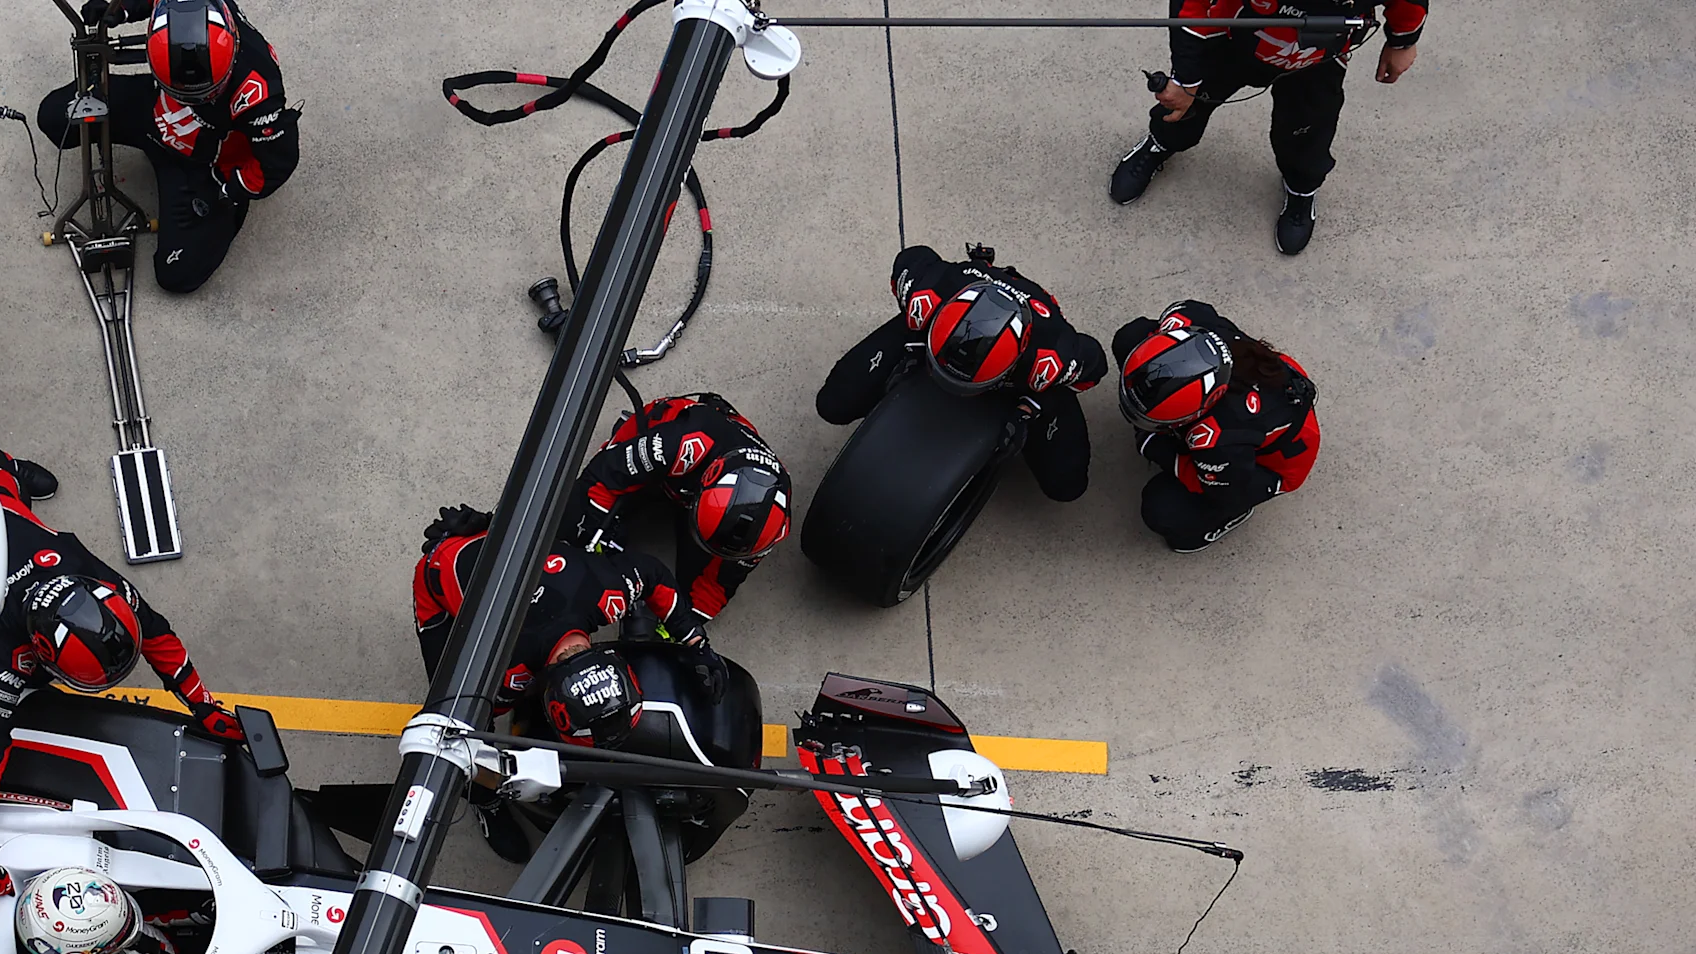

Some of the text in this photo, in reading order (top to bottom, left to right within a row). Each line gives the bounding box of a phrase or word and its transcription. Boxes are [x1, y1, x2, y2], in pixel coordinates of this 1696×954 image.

[569, 664, 620, 697] Angels
[581, 679, 623, 707] Palm
[1, 792, 68, 811] CHIPOTL
[198, 847, 223, 887] MoneyGram
[32, 888, 50, 921] HAAS
[66, 882, 83, 909] 20
[65, 919, 110, 935] MoneyGram
